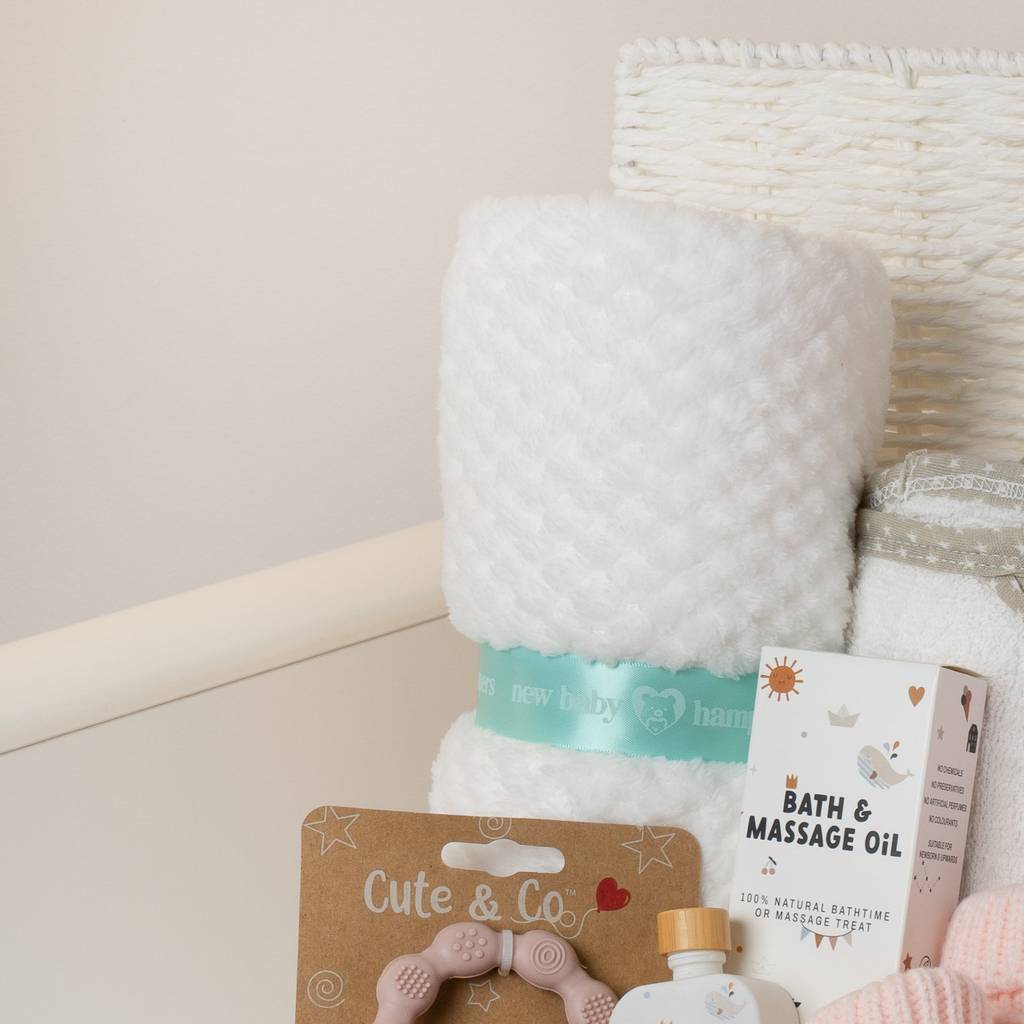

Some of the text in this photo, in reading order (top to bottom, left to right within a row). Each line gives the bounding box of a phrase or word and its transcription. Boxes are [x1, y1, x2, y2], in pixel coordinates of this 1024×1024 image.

[512, 684, 554, 707] new
[560, 685, 618, 723] baby
[693, 699, 753, 734] ham
[783, 790, 872, 822] BATH &
[746, 815, 856, 851] MASSAGE
[364, 869, 452, 918] Cute
[469, 884, 502, 921] &
[740, 892, 890, 922] 100% NATURAL BATHTIME
[755, 907, 872, 933] OR MASSAGE TREAT
